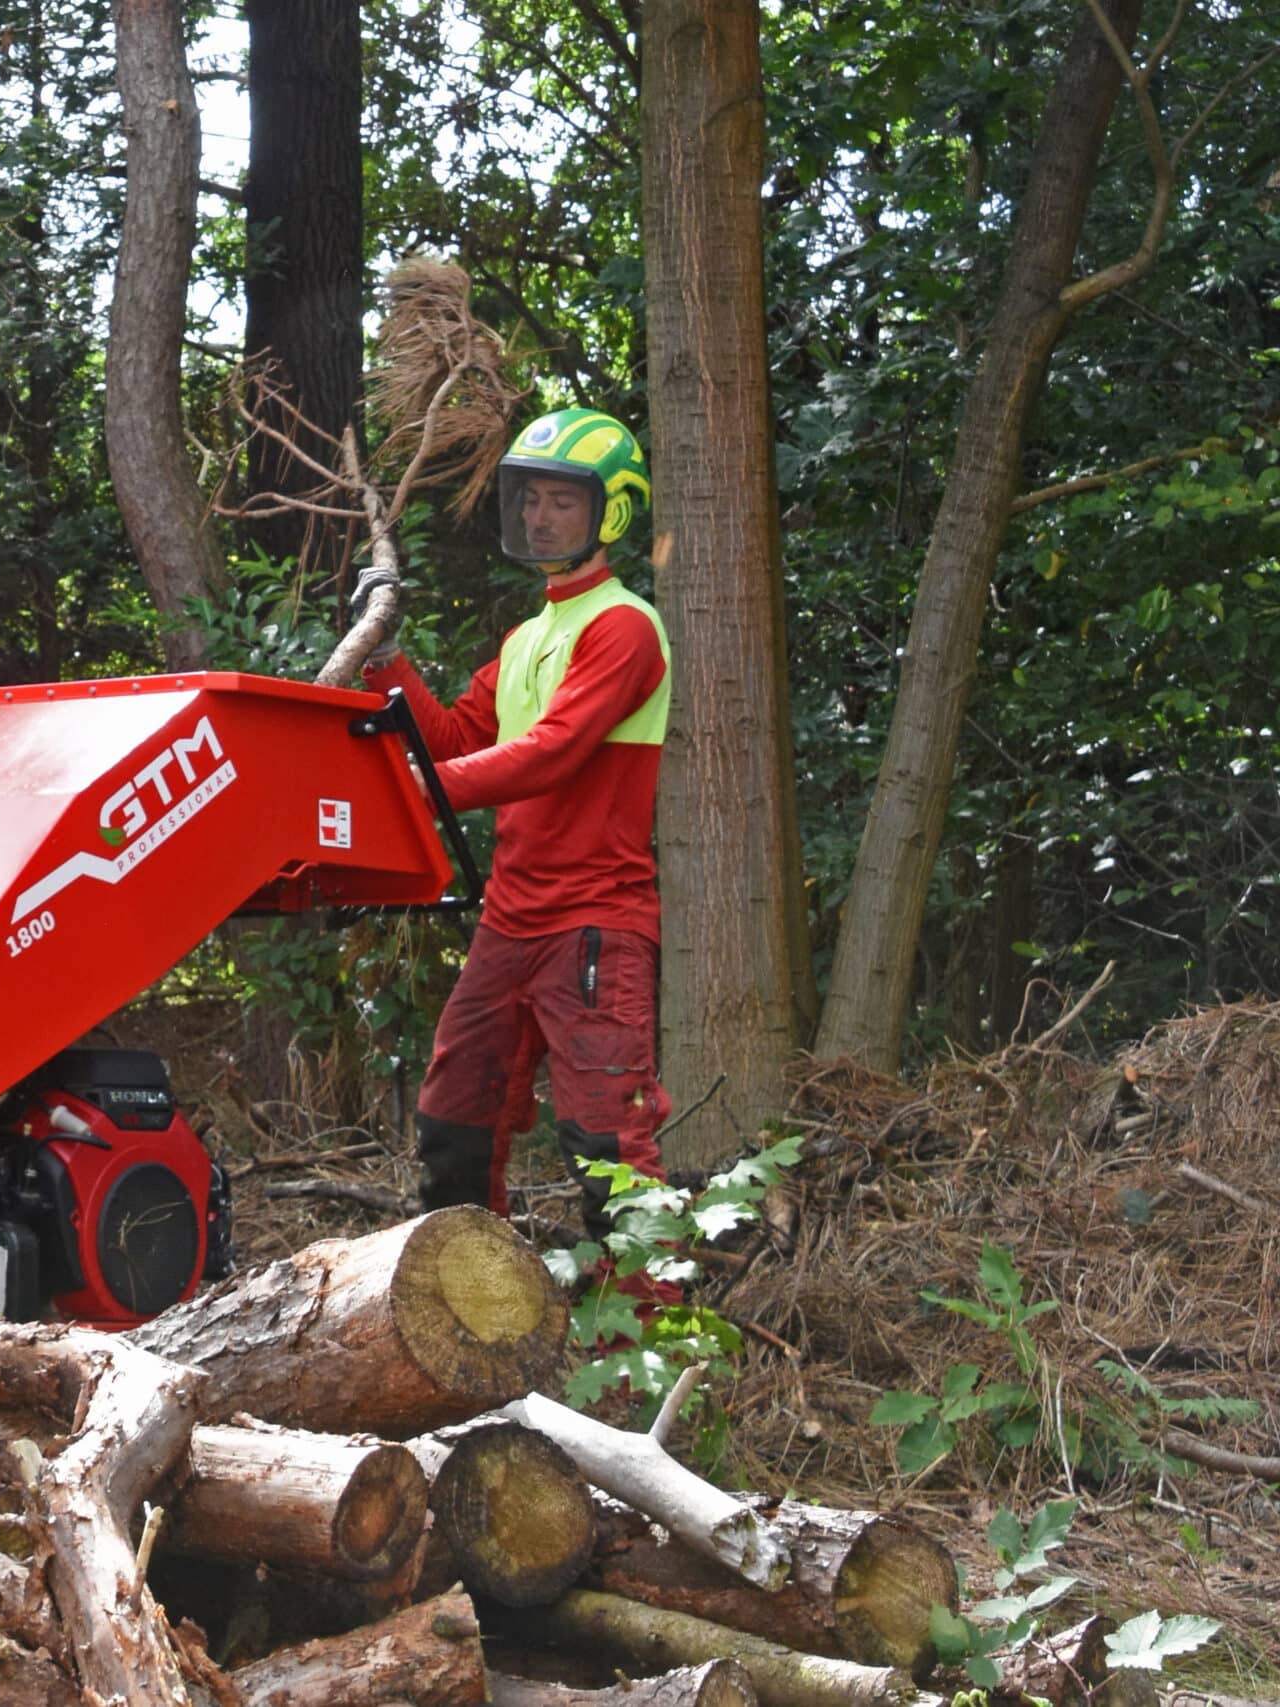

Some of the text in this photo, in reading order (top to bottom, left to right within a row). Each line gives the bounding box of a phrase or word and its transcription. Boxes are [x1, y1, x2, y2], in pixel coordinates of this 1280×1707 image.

[99, 715, 223, 846] GTM
[117, 767, 232, 872] PROFESSIONAL
[6, 910, 55, 957] 1800
[110, 1090, 168, 1104] HONDA
